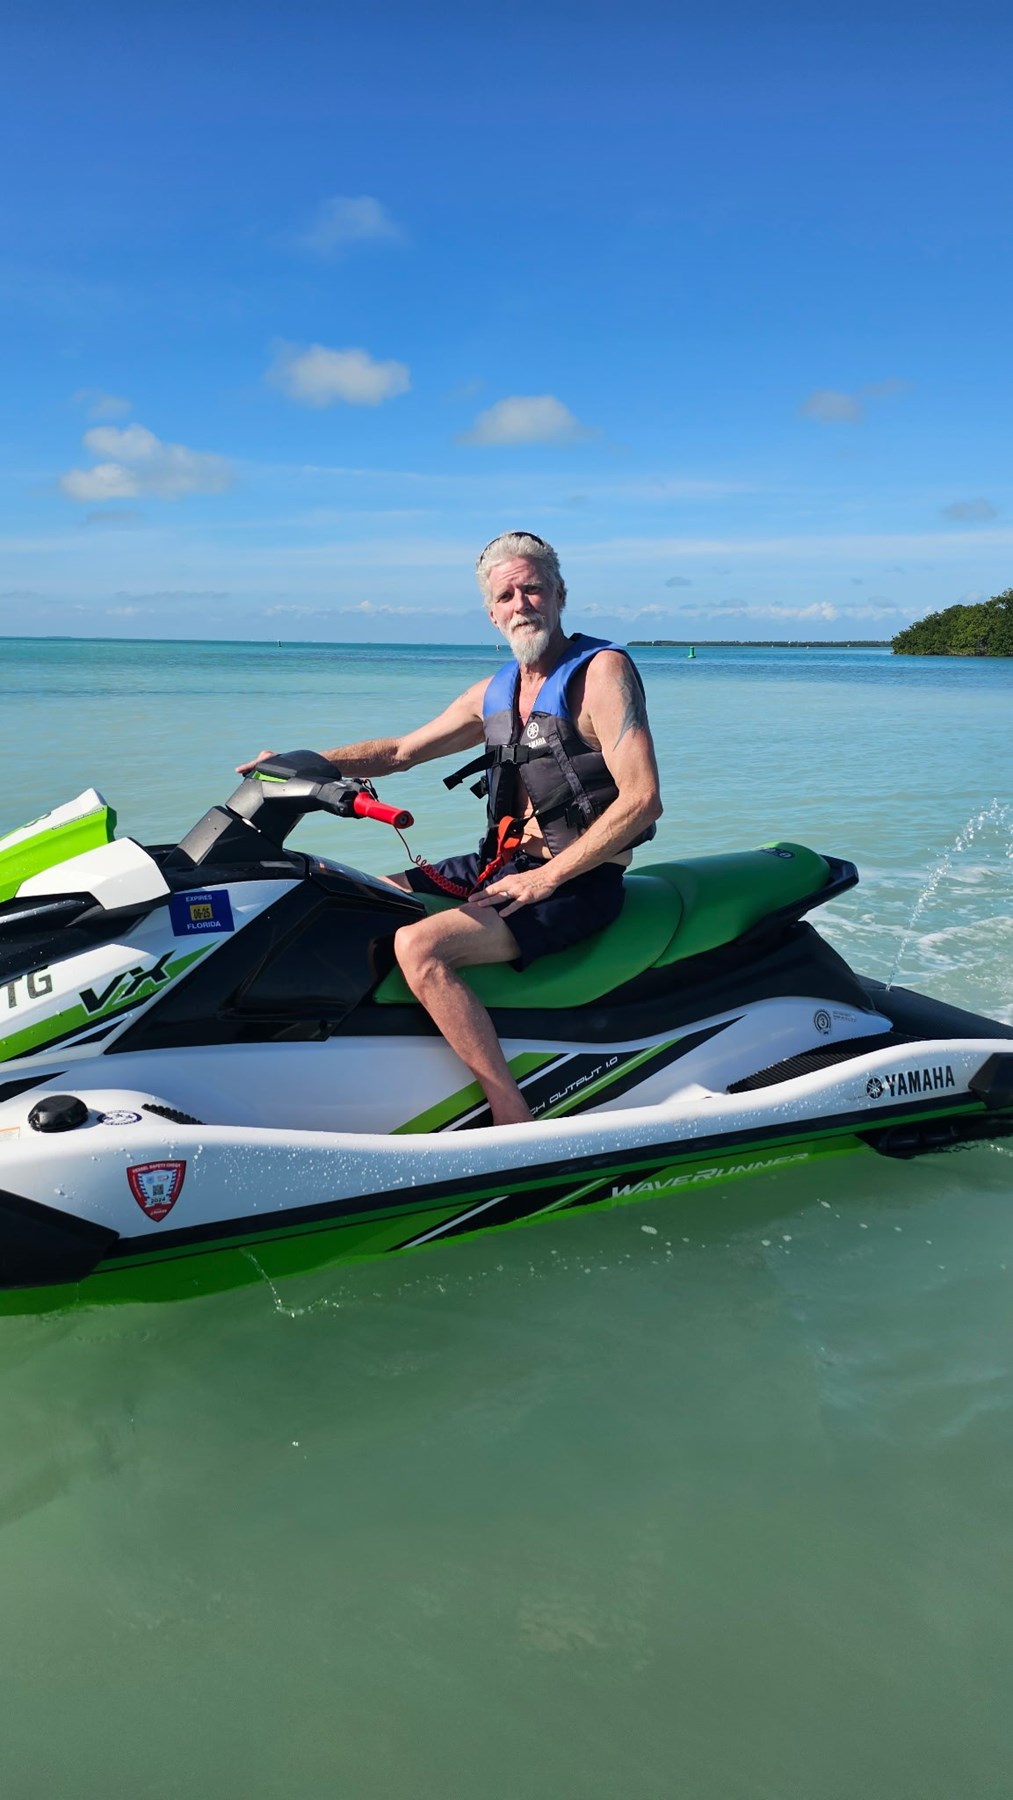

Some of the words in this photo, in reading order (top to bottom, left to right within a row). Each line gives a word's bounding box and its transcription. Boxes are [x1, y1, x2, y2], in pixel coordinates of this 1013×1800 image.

[524, 737, 547, 749] AMAHA
[185, 894, 213, 902] EXPIRES
[186, 920, 222, 930] FLORIDA
[78, 948, 177, 1015] VX
[549, 1066, 602, 1104] OUTPUT
[885, 1065, 956, 1097] YAMAHA
